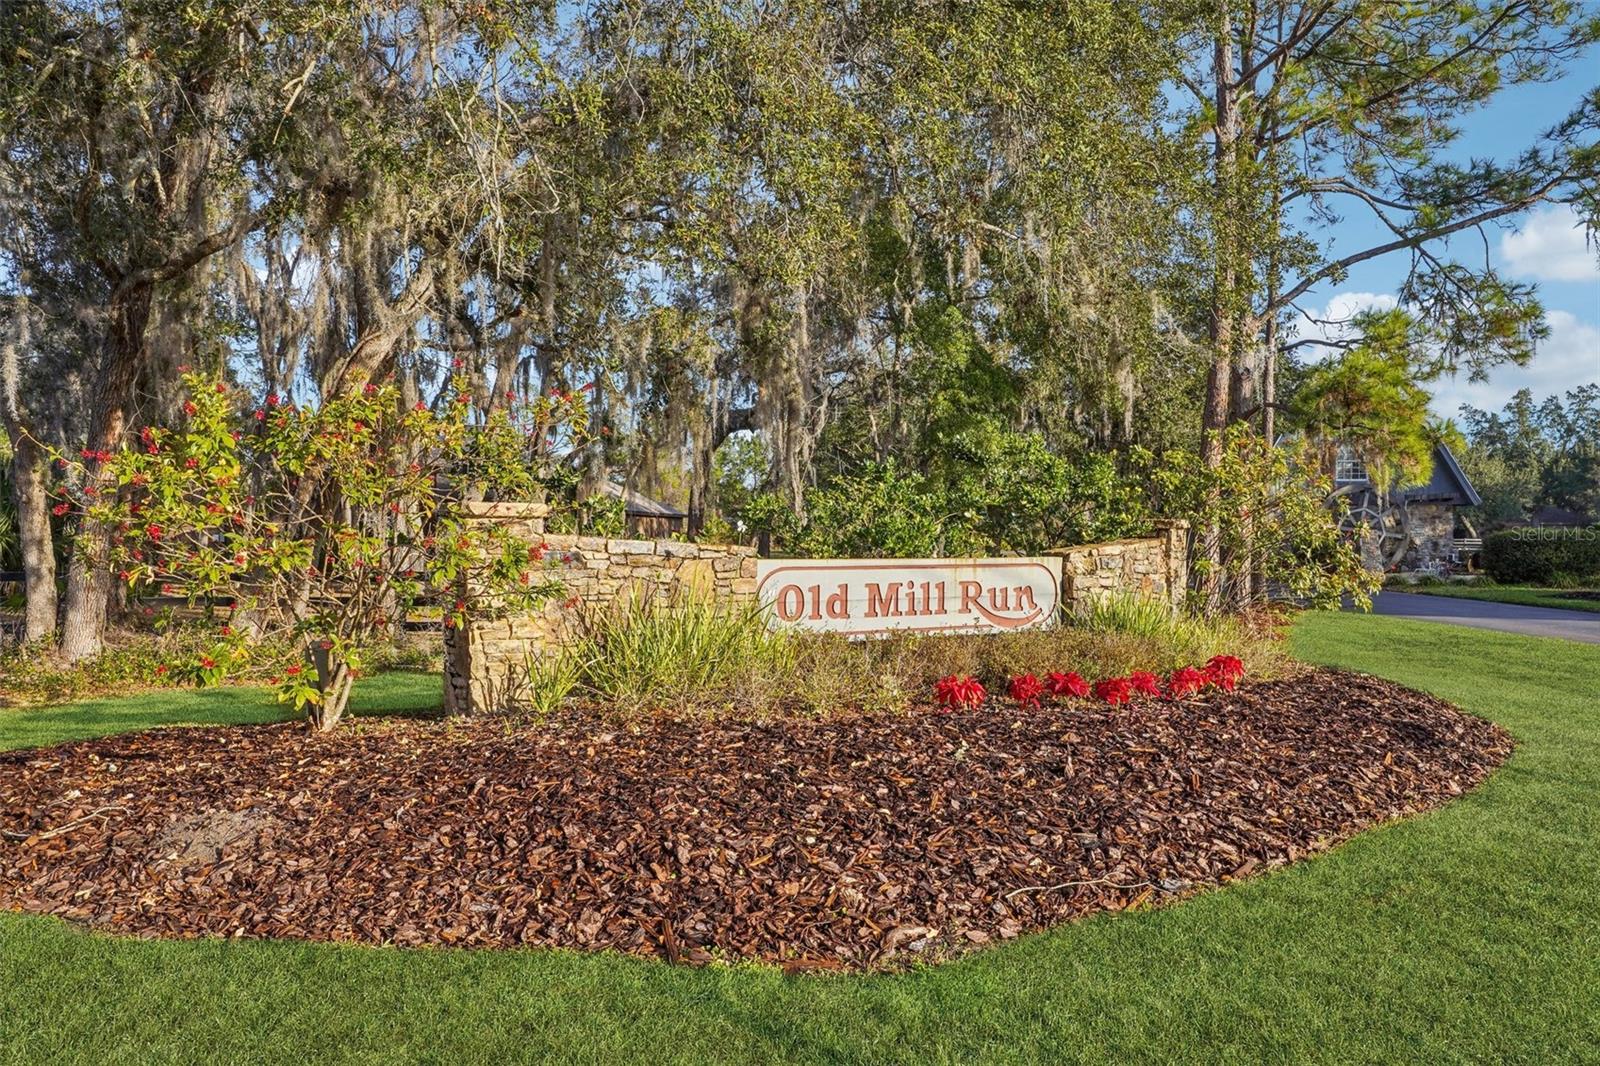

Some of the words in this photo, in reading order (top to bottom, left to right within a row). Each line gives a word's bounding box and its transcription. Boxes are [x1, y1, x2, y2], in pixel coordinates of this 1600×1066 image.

[776, 582, 850, 622] Old
[864, 580, 947, 618] Mill
[958, 580, 1043, 627] Run
